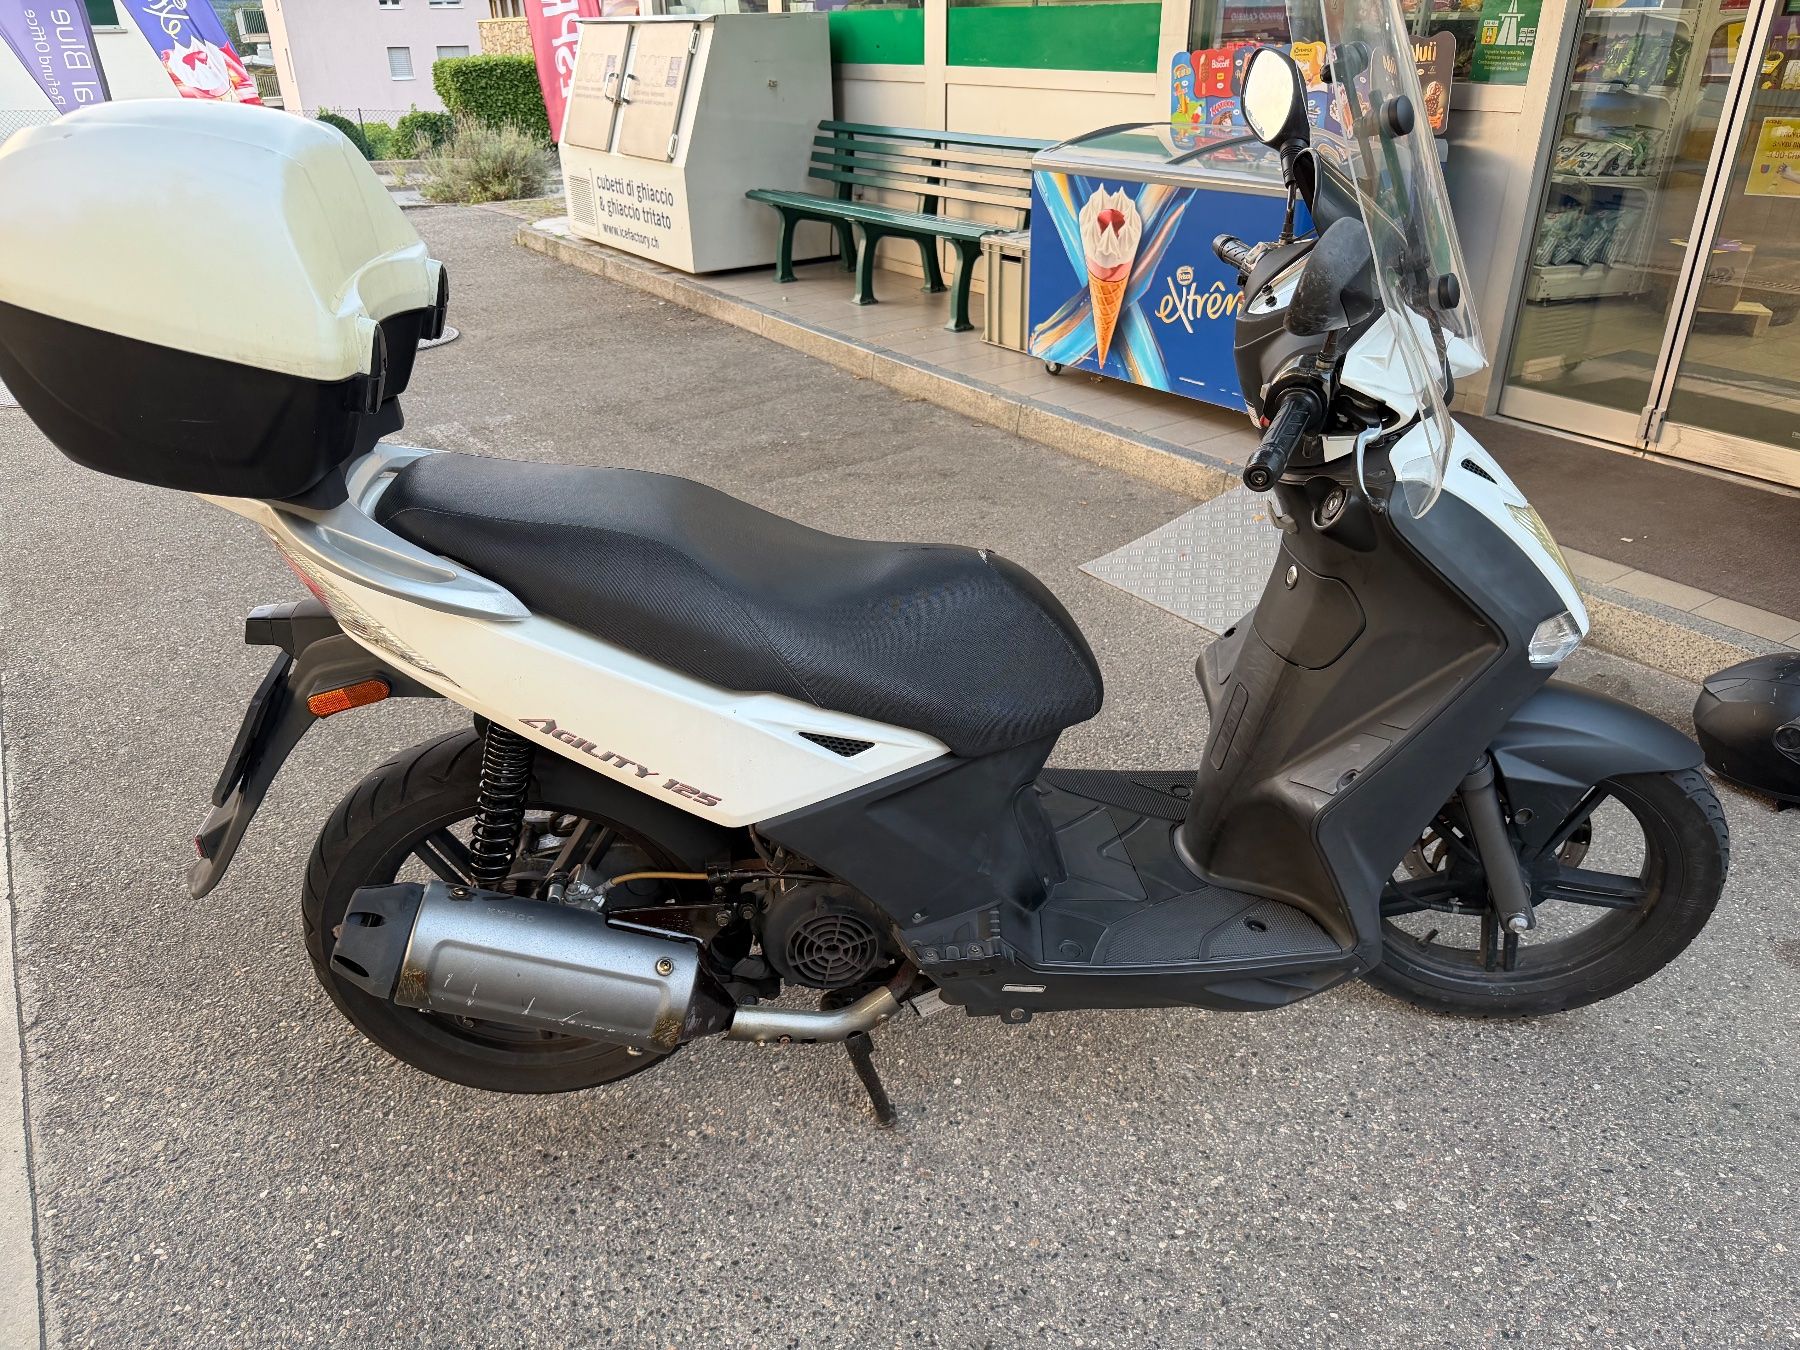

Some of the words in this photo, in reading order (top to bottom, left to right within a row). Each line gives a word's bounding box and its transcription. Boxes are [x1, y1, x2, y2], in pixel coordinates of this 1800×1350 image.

[596, 174, 624, 195] cubetti
[626, 179, 634, 197] di
[636, 182, 674, 206] ghiaccio
[599, 195, 605, 211] &
[607, 198, 640, 217] ghiaccio
[642, 206, 672, 229] tritato
[603, 223, 660, 249] www.icefactory.ch
[1155, 276, 1245, 334] extrêm
[518, 718, 659, 778] AGILITY
[662, 778, 722, 806] 125
